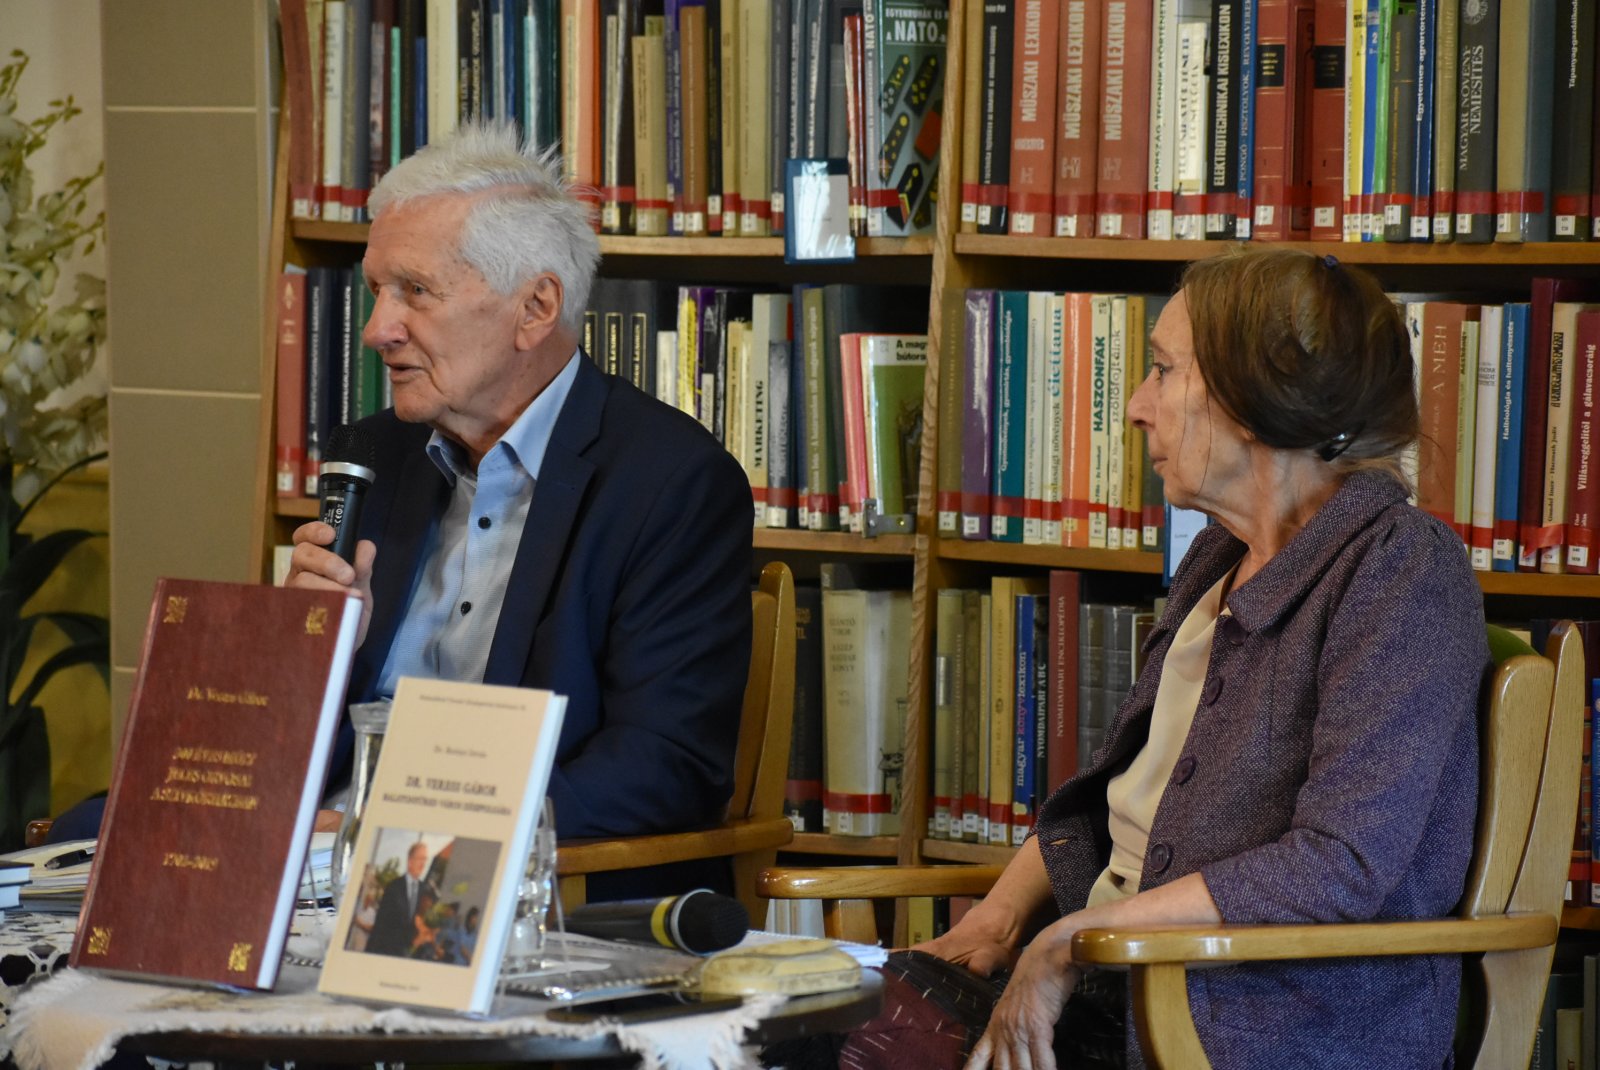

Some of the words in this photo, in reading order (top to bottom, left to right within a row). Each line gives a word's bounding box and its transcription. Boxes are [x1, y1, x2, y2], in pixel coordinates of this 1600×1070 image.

[885, 31, 892, 41] A
[1023, 0, 1041, 55] LEXIKON
[1066, 0, 1085, 65] LEXIKON
[1106, 1, 1125, 66] LEXIKON
[1217, 4, 1231, 75] KISLEXIKON
[1019, 61, 1039, 122] MŰSZAKI
[1063, 68, 1082, 140] MŰSZAKI
[1102, 69, 1123, 141] MŰSZAKI
[1415, 65, 1425, 121] Egyetemes
[1469, 45, 1484, 134] NEMESÍTÉS
[1213, 78, 1229, 186] ELEKTROTECHNIKAI
[1459, 112, 1469, 171] MAGYAR
[896, 339, 903, 348] A
[1505, 321, 1515, 378] haltenyésztés
[1091, 336, 1106, 432] HASZONFÁK
[1431, 381, 1445, 397] A
[1504, 380, 1512, 390] és
[1582, 344, 1596, 408] gálavacsoráig
[754, 380, 764, 468] MARKETING
[1052, 402, 1061, 452] növények
[1502, 391, 1513, 440] Halbiológia
[1577, 421, 1591, 490] Villásreggelitől
[1056, 596, 1066, 665] ENCIKLOPÉDIA
[1038, 662, 1047, 688] ABC
[1056, 668, 1065, 737] NYOMDAIPARI
[1036, 690, 1046, 758] NYOMDAIPARI
[405, 775, 421, 789] DR.
[462, 780, 498, 797] GÁBOR
[1015, 737, 1026, 787] magyar
